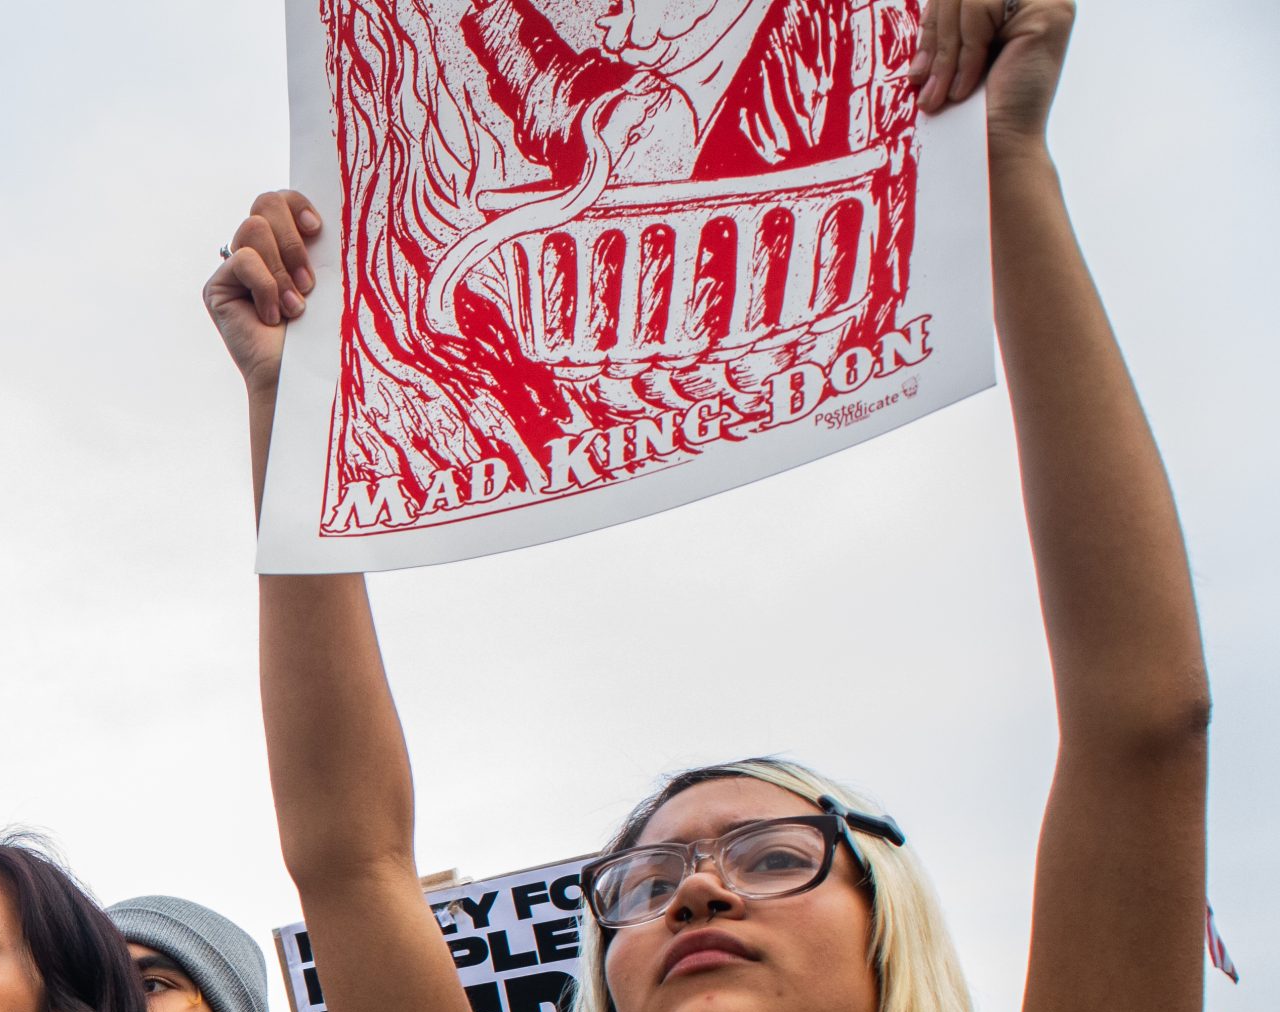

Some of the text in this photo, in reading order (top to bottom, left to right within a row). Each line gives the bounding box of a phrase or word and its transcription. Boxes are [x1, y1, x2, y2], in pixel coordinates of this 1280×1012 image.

[320, 314, 933, 533] MAD KING DON
[814, 400, 862, 426] Poster
[827, 392, 899, 429] Syndicate
